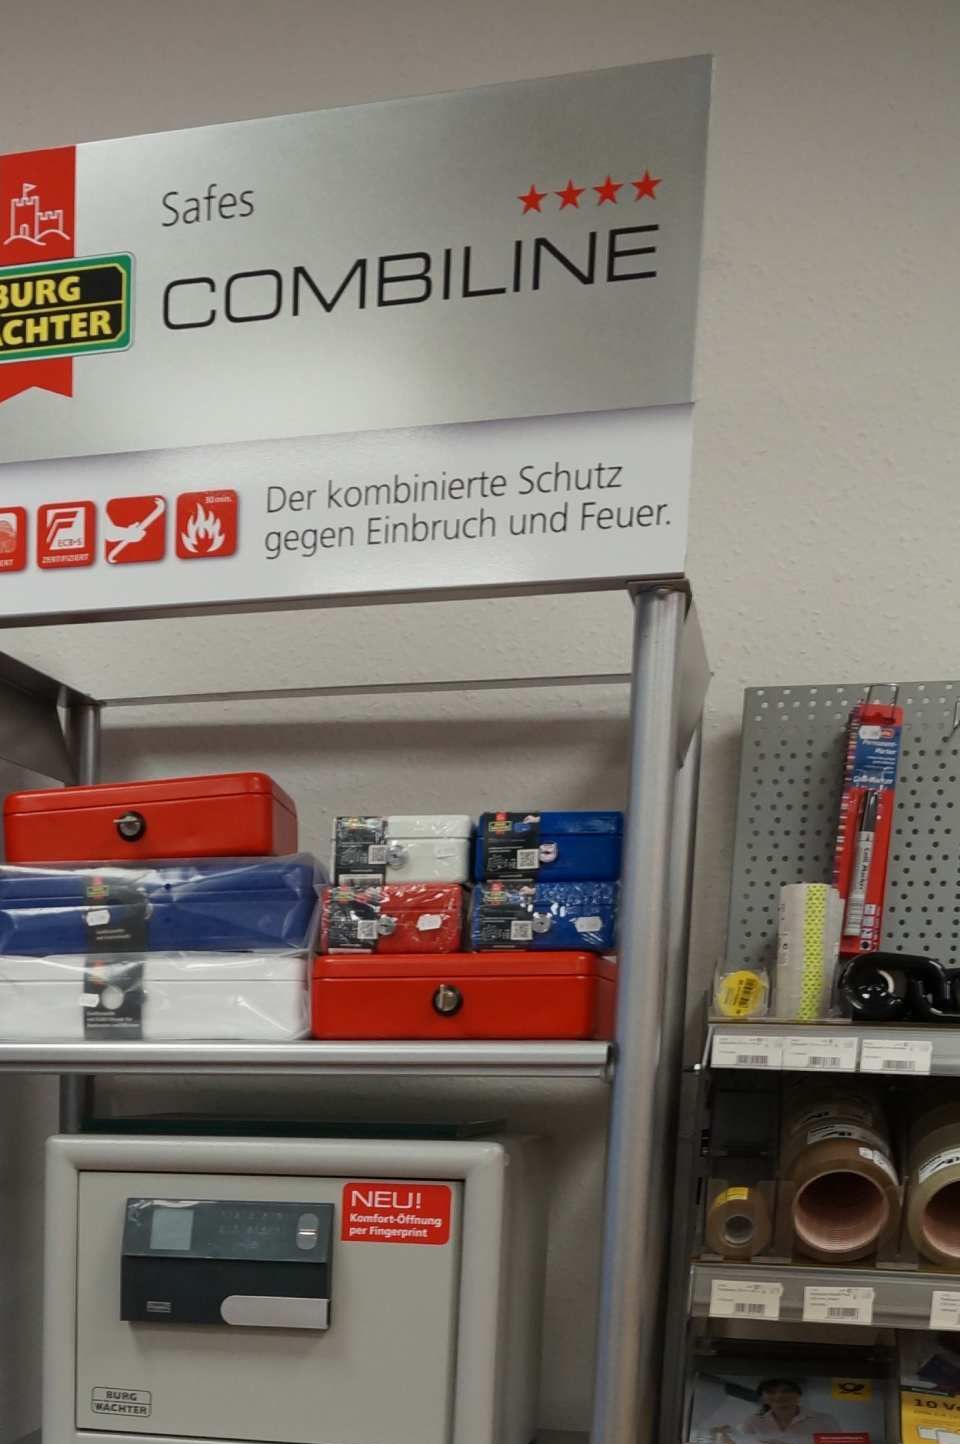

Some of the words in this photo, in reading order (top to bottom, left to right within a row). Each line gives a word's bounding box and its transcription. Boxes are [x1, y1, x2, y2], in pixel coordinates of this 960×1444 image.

[161, 182, 255, 228] Safes
[162, 223, 660, 331] COMBILINE
[266, 485, 317, 514] Der
[327, 472, 508, 509] kombinierte
[518, 462, 624, 496] Schutz
[264, 523, 355, 561] gegen
[367, 507, 497, 546] Einbruch
[509, 502, 569, 537] und
[580, 501, 672, 531] Feuer.
[351, 1190, 422, 1209] NEU!
[349, 1213, 443, 1228] Komfort-Öffnung
[349, 1227, 368, 1237] per
[369, 1226, 429, 1239] Fingerprint
[105, 1391, 138, 1401] BURG
[914, 1398, 938, 1409] 10
